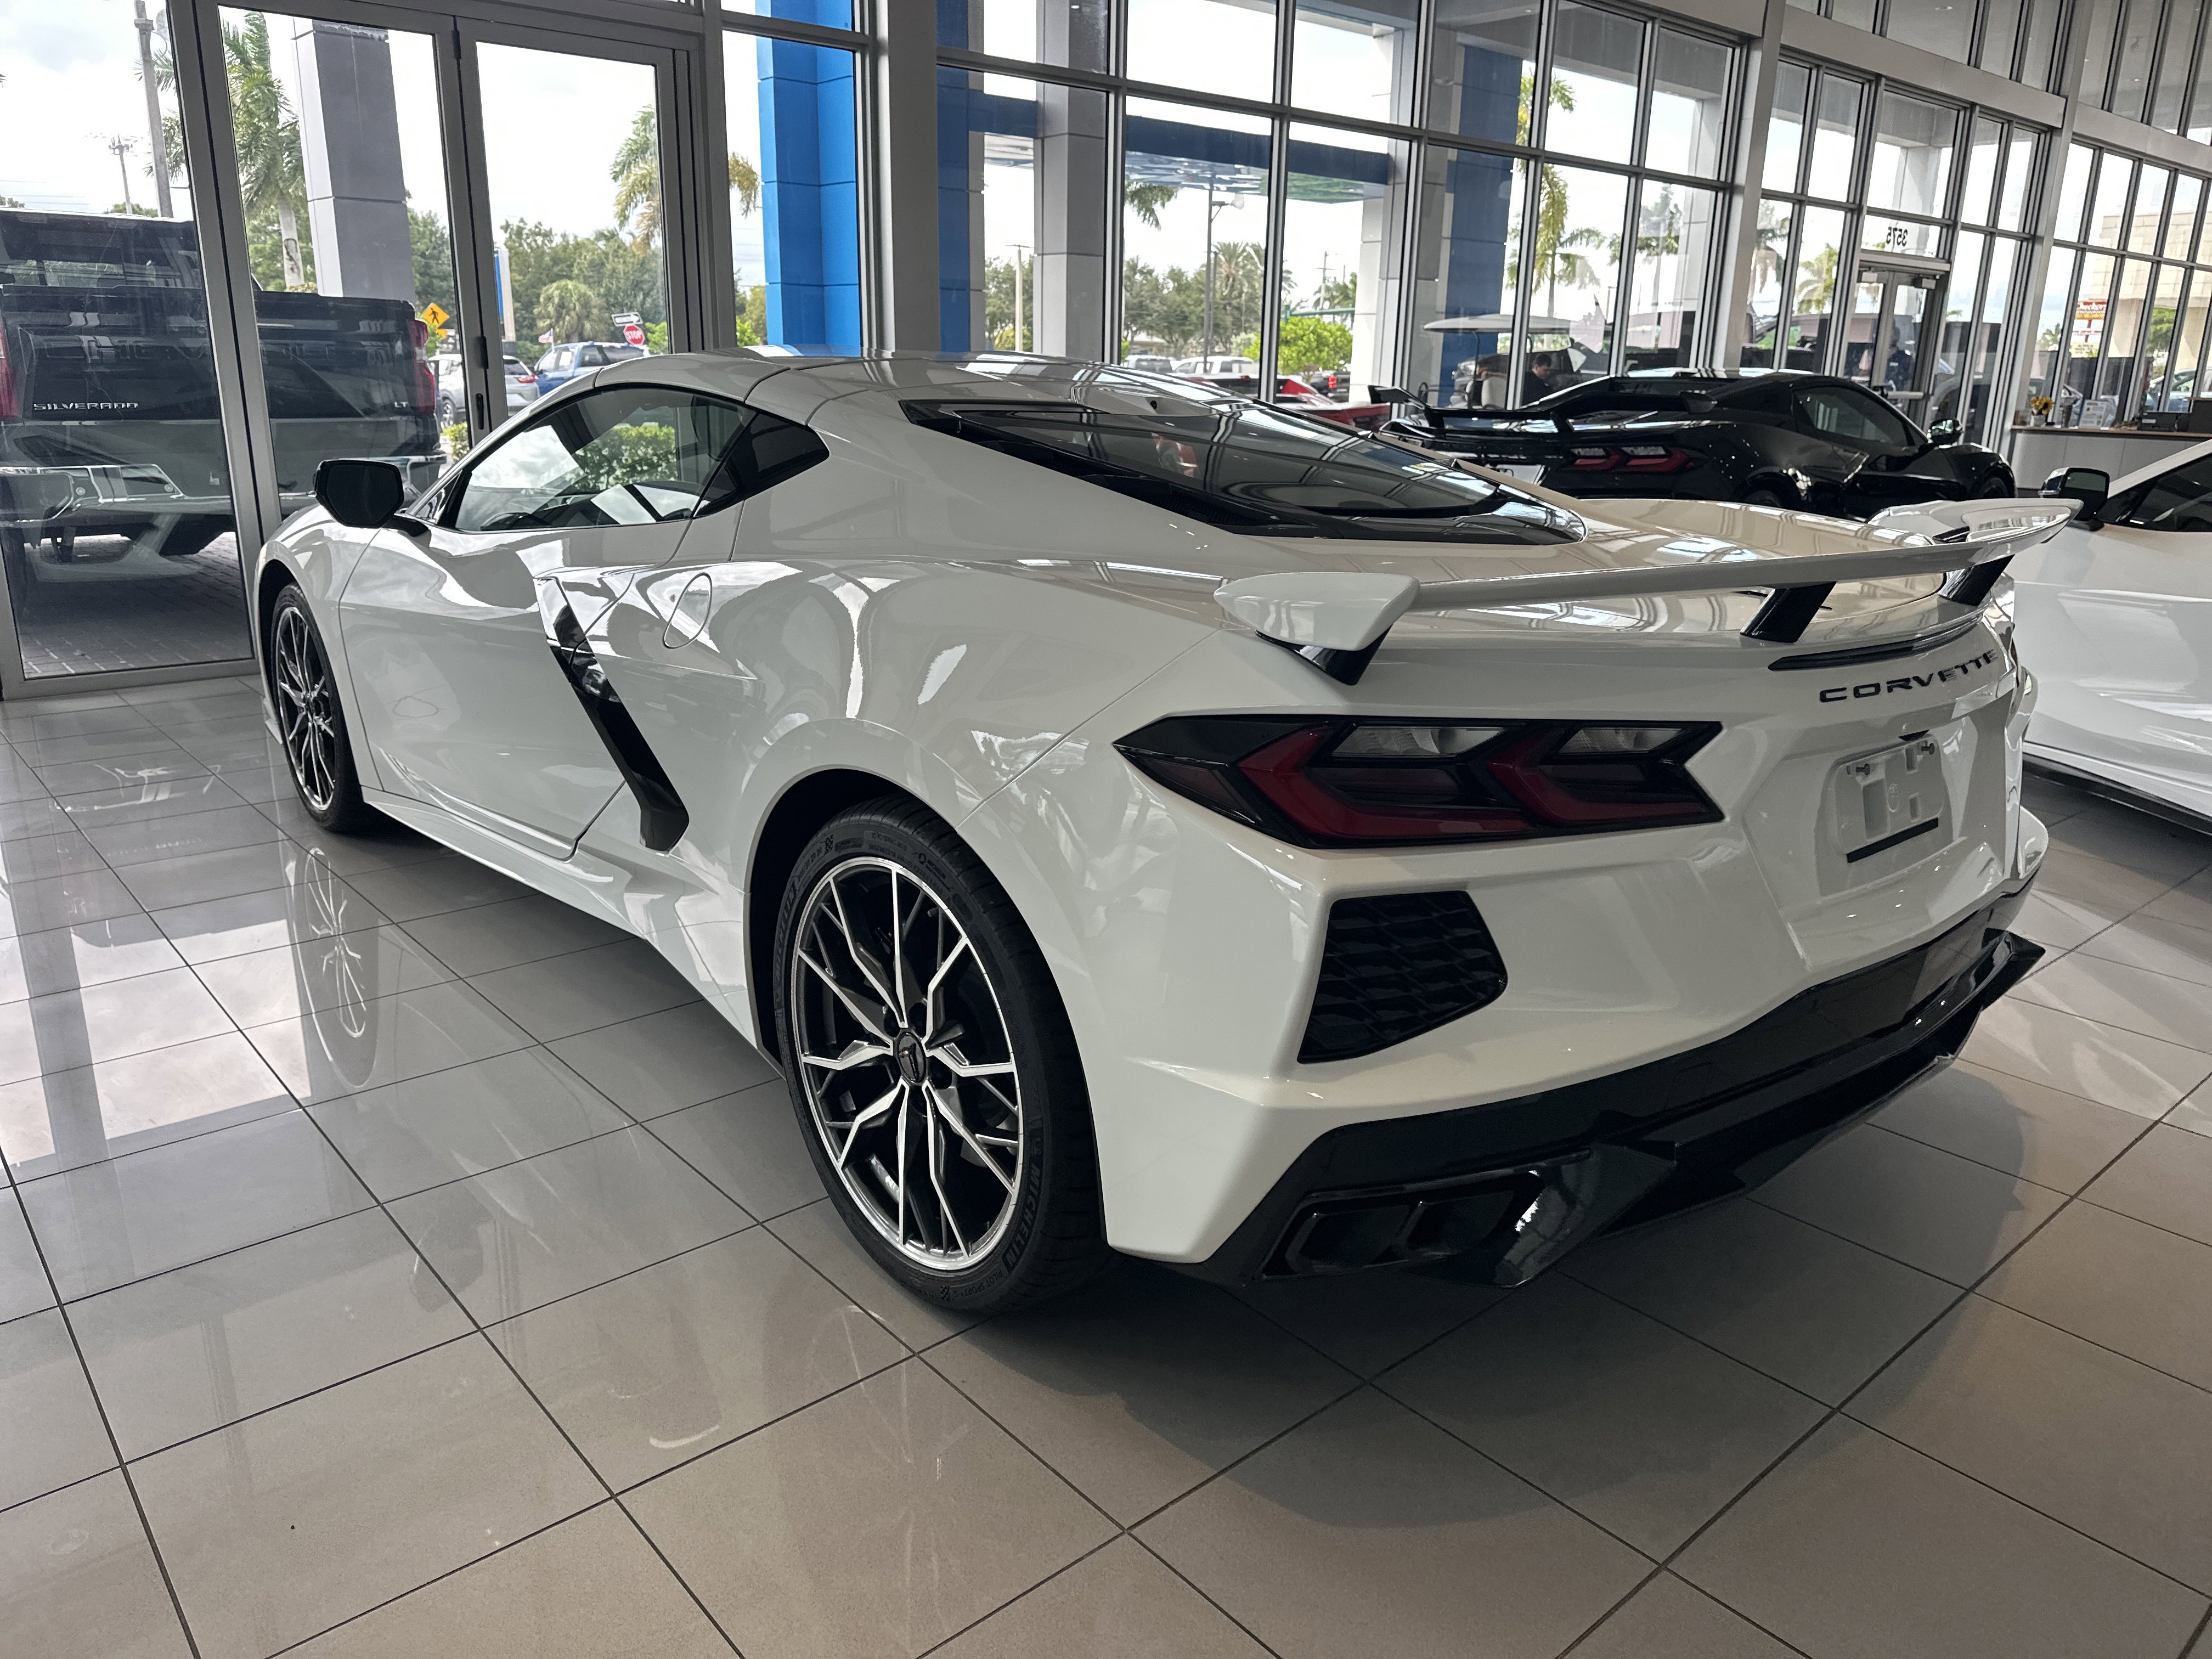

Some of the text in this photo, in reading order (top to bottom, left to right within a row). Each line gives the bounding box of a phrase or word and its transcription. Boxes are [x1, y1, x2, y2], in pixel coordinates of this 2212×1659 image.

[625, 330, 642, 340] STOP
[33, 402, 138, 410] SILVERADO
[1819, 649, 1998, 702] CORVETTE
[1006, 1163, 1041, 1268] MICHELIN
[986, 1268, 1004, 1288] PILOT
[964, 1281, 986, 1296] SPORT
